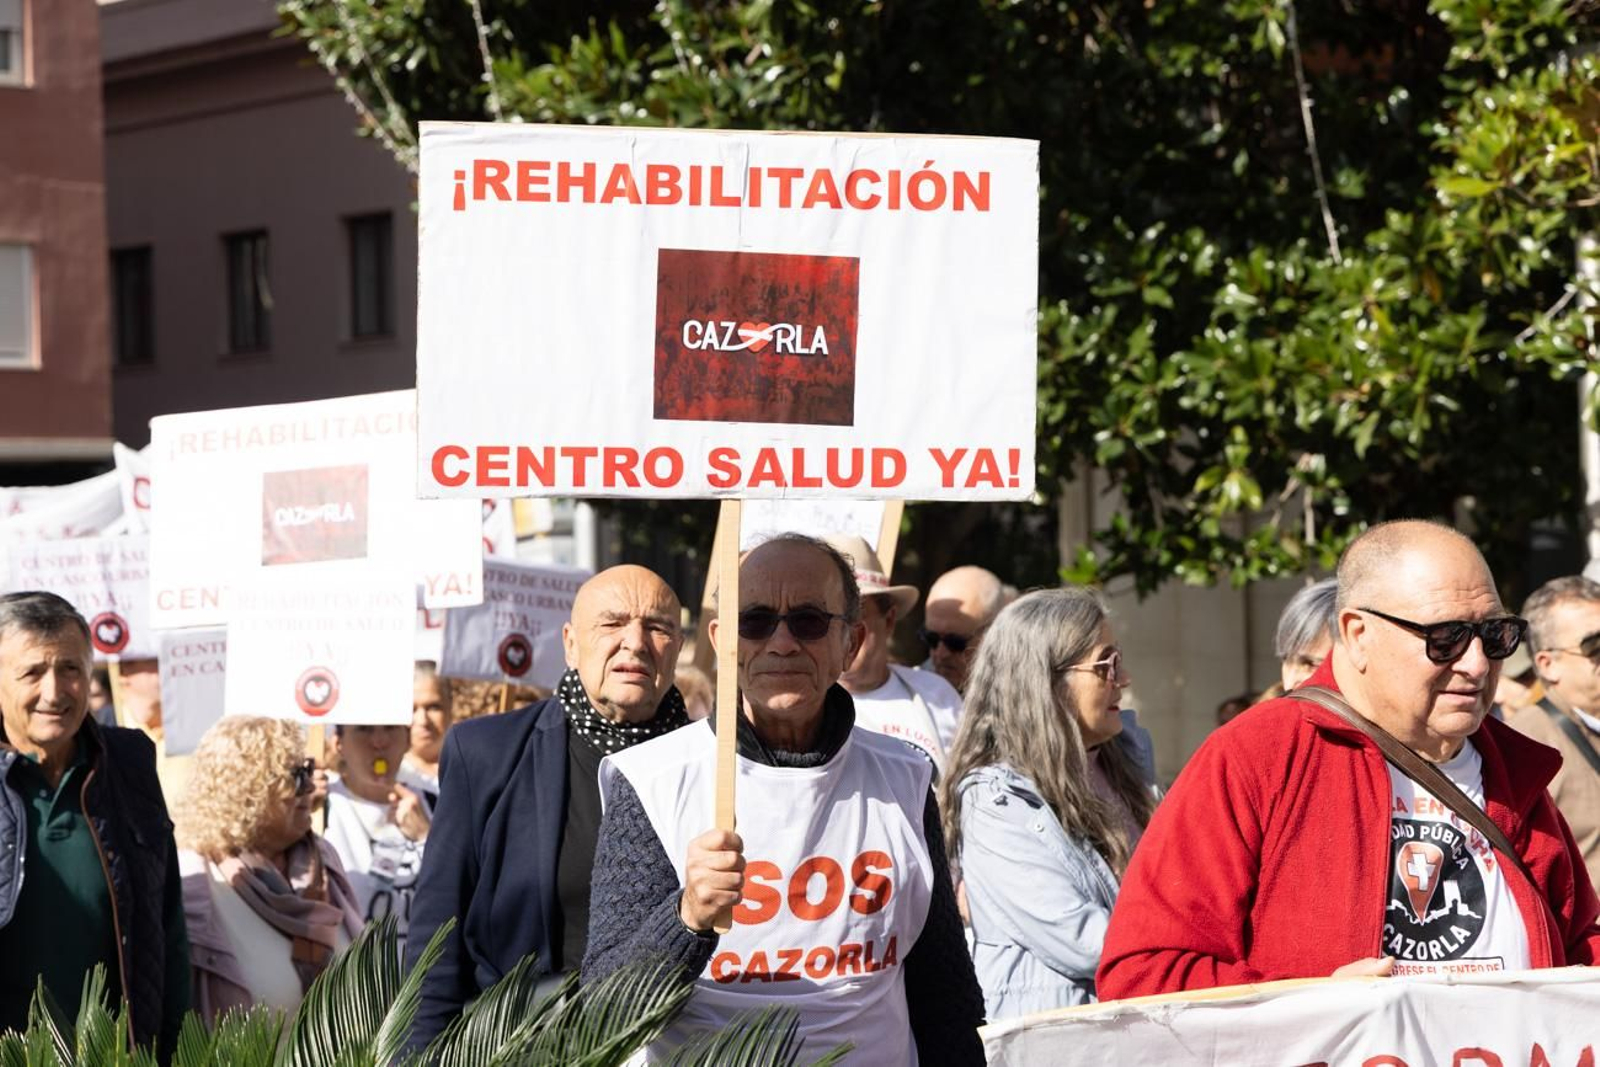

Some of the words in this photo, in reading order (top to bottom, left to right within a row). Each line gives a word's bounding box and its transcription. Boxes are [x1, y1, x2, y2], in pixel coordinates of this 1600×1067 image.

[452, 159, 991, 212] ¡REHABILITACIÓN
[431, 445, 685, 488] CENTRO
[706, 447, 907, 489] SALUD
[927, 447, 1021, 489] YA!
[157, 585, 232, 611] CEN
[424, 574, 473, 597] YA!
[1414, 797, 1445, 815] EN
[731, 850, 894, 926] SOS
[710, 935, 898, 984] CAZORLA
